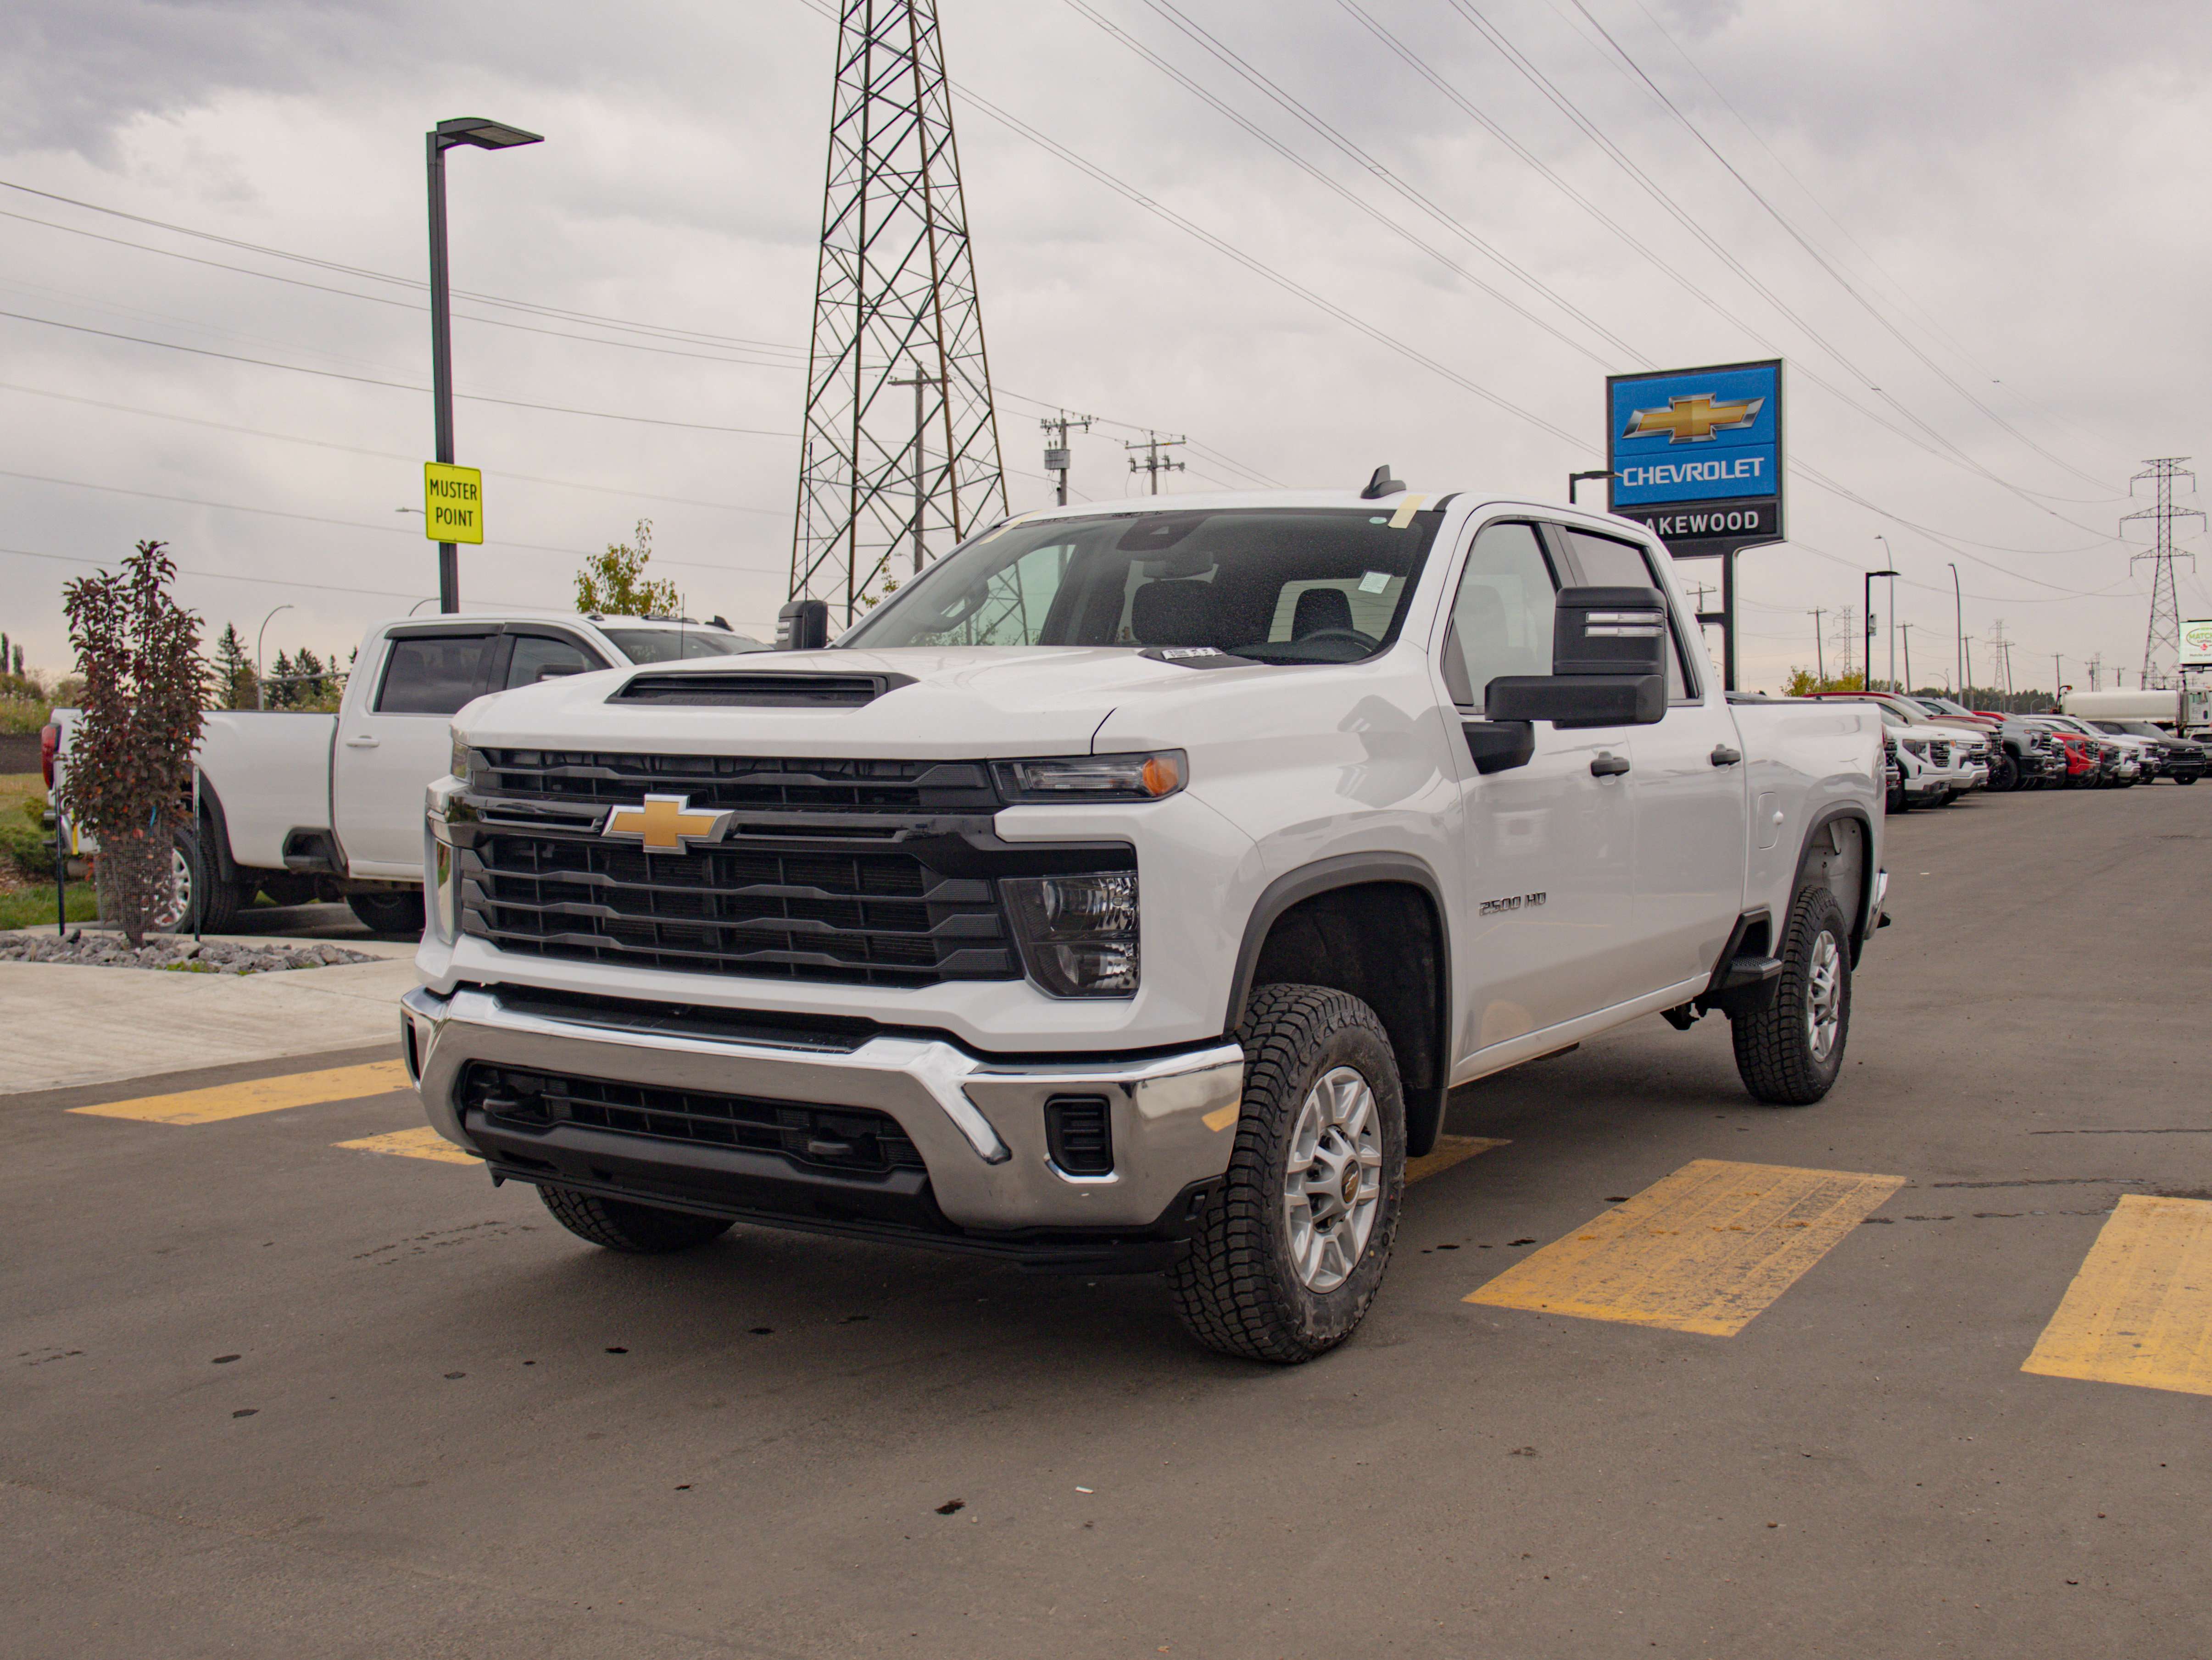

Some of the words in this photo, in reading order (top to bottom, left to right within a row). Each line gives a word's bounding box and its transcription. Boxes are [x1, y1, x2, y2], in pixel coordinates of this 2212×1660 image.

[1623, 457, 1765, 487] CHEVROLET
[429, 478, 477, 501] MUSTER
[435, 506, 474, 527] POINT
[1645, 511, 1759, 535] AKEWOOD
[1479, 896, 1521, 916] 2500
[1525, 892, 1546, 908] HD
